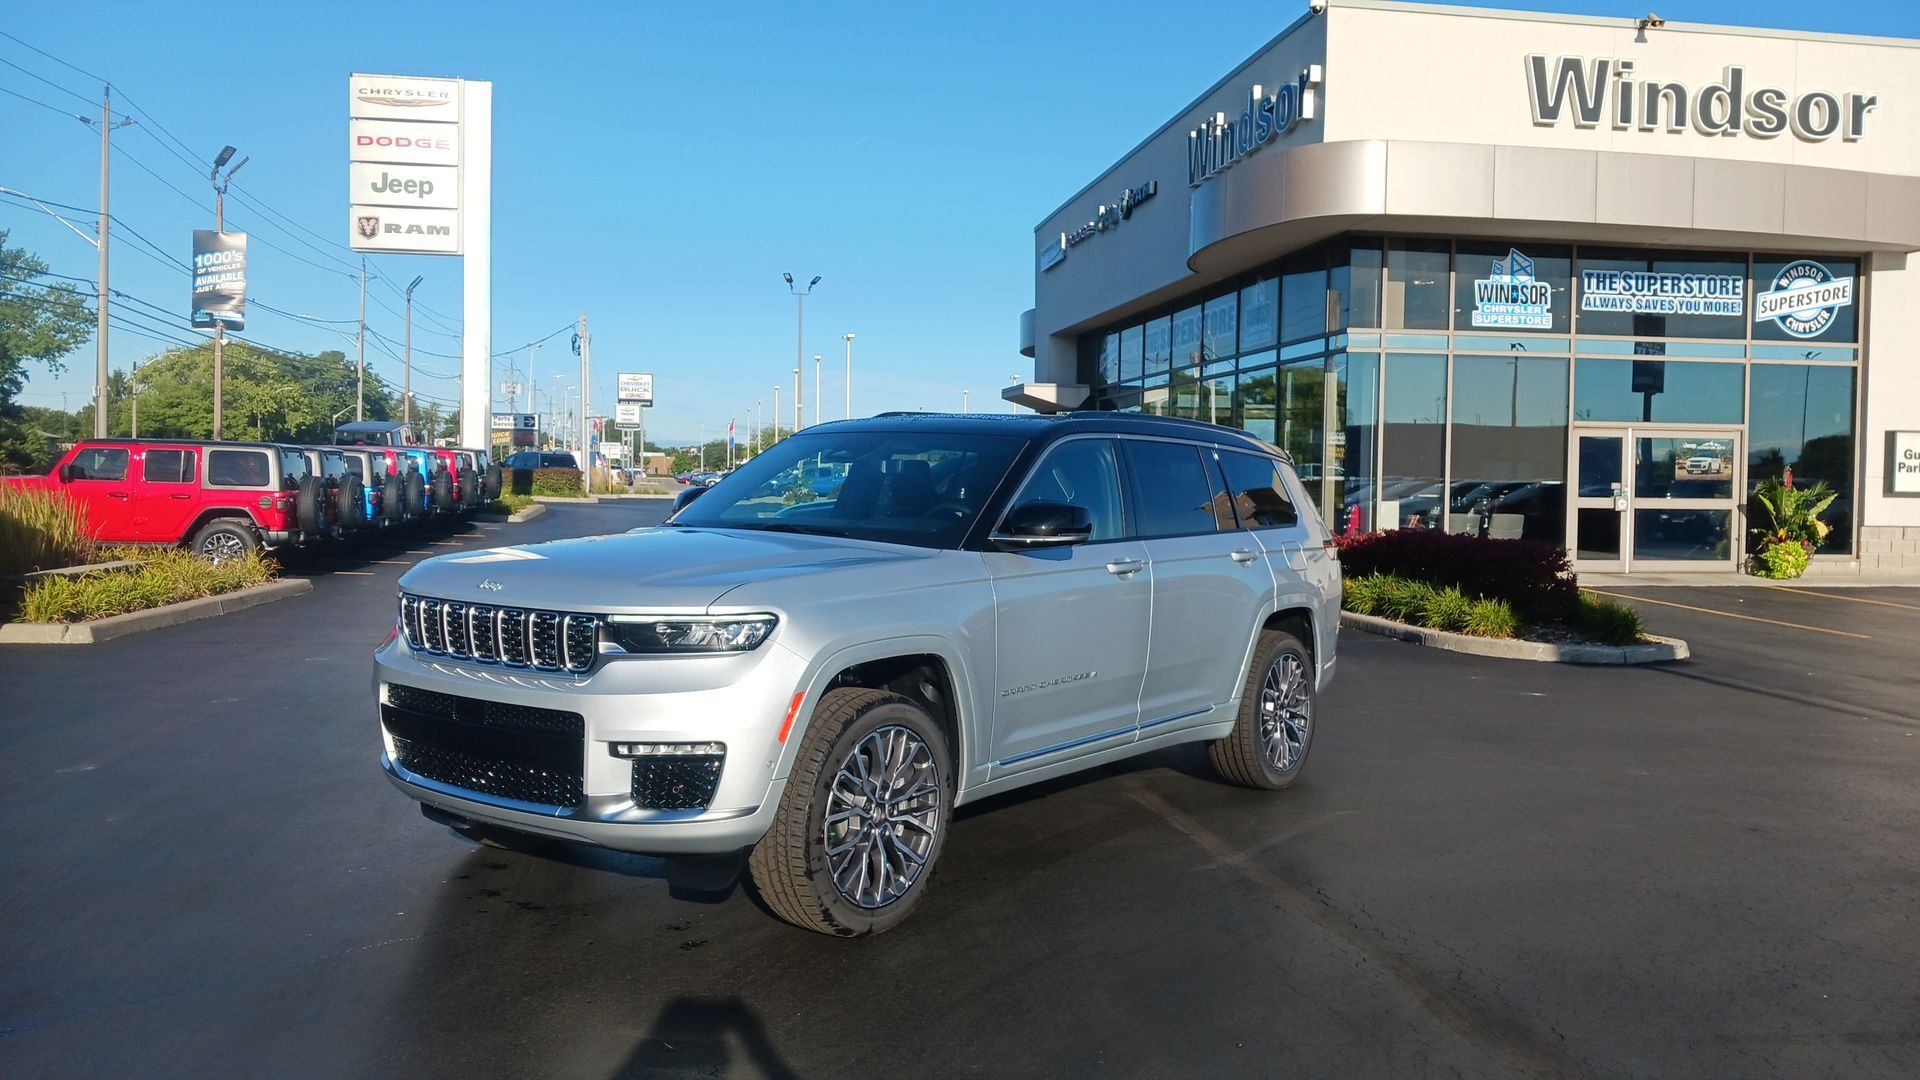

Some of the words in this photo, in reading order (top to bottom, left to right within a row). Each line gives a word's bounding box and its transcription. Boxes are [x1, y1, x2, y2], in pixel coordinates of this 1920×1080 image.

[358, 87, 449, 99] CHRYSLER
[1525, 53, 1878, 142] Windsor
[1187, 64, 1321, 188] Windsor
[356, 135, 451, 150] DODGE
[371, 172, 434, 198] Jeep
[384, 223, 450, 236] RAM
[195, 271, 244, 287] AVAILABLE
[1583, 272, 1618, 291] THE
[1622, 273, 1743, 296] SUPERSTORE
[1779, 266, 1825, 288] WINDSOR
[195, 284, 214, 293] JUST
[1478, 283, 1548, 305] WINDSOR
[1584, 296, 1633, 310] ALWAYS
[1636, 298, 1675, 311] SAVES
[1677, 300, 1701, 312] YOU
[1703, 301, 1742, 313] MORE!
[1760, 285, 1850, 314] SUPERSTORE
[1483, 305, 1542, 315] CHRYSLER
[1475, 314, 1550, 325] SUPERSTORE
[1785, 310, 1831, 333] CHRYSLER
[1001, 684, 1038, 697] GRAND
